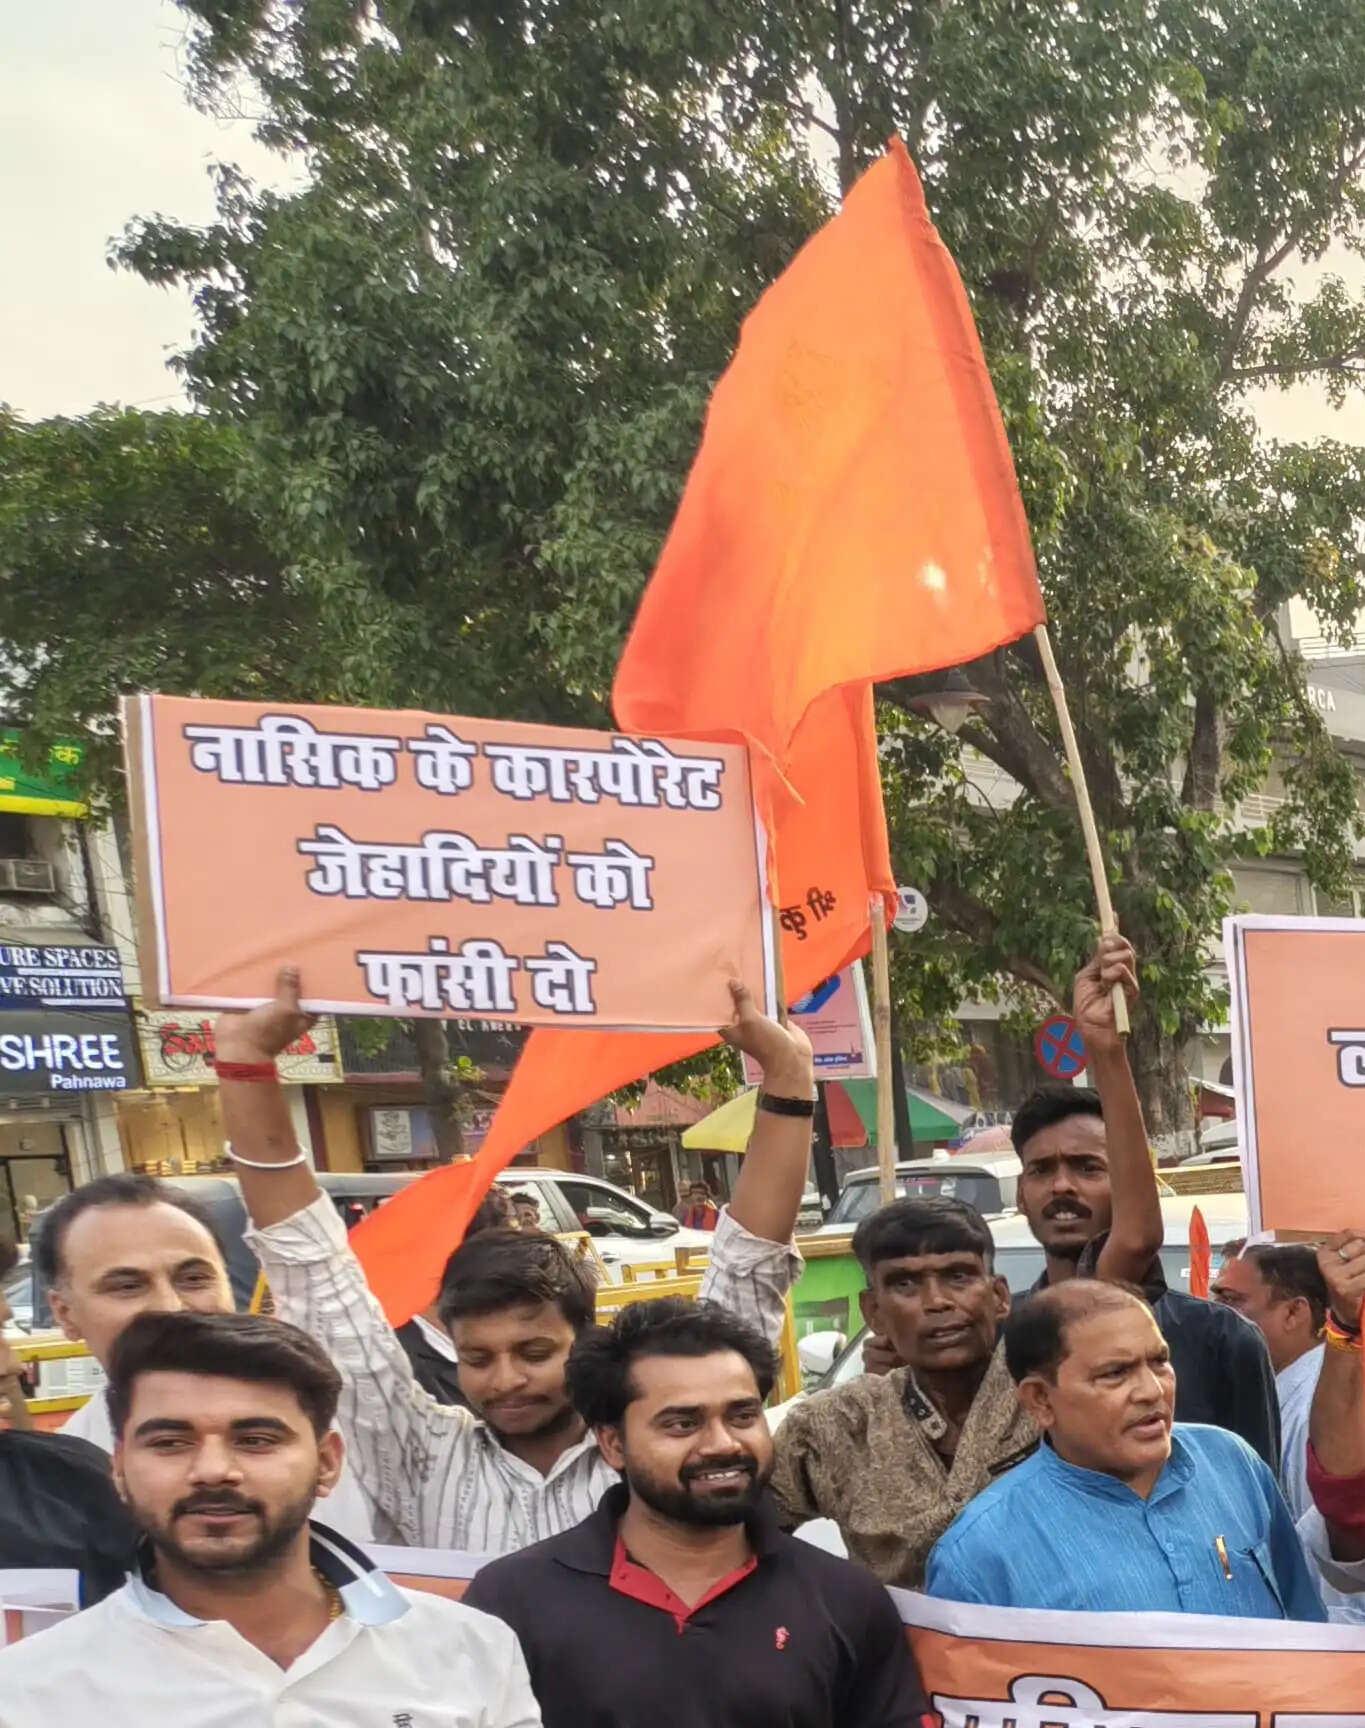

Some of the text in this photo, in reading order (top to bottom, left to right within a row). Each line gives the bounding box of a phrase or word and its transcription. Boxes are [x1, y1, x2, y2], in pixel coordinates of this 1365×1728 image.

[184, 714, 724, 811] नासिक के कारपोरेट
[299, 825, 654, 911] जेहादियों को
[44, 947, 119, 969] SPACES
[29, 977, 123, 996] SOLUTION
[357, 939, 596, 1015] फांसी दो
[0, 1034, 125, 1070] SHREE
[51, 1074, 126, 1089] Pahnawa
